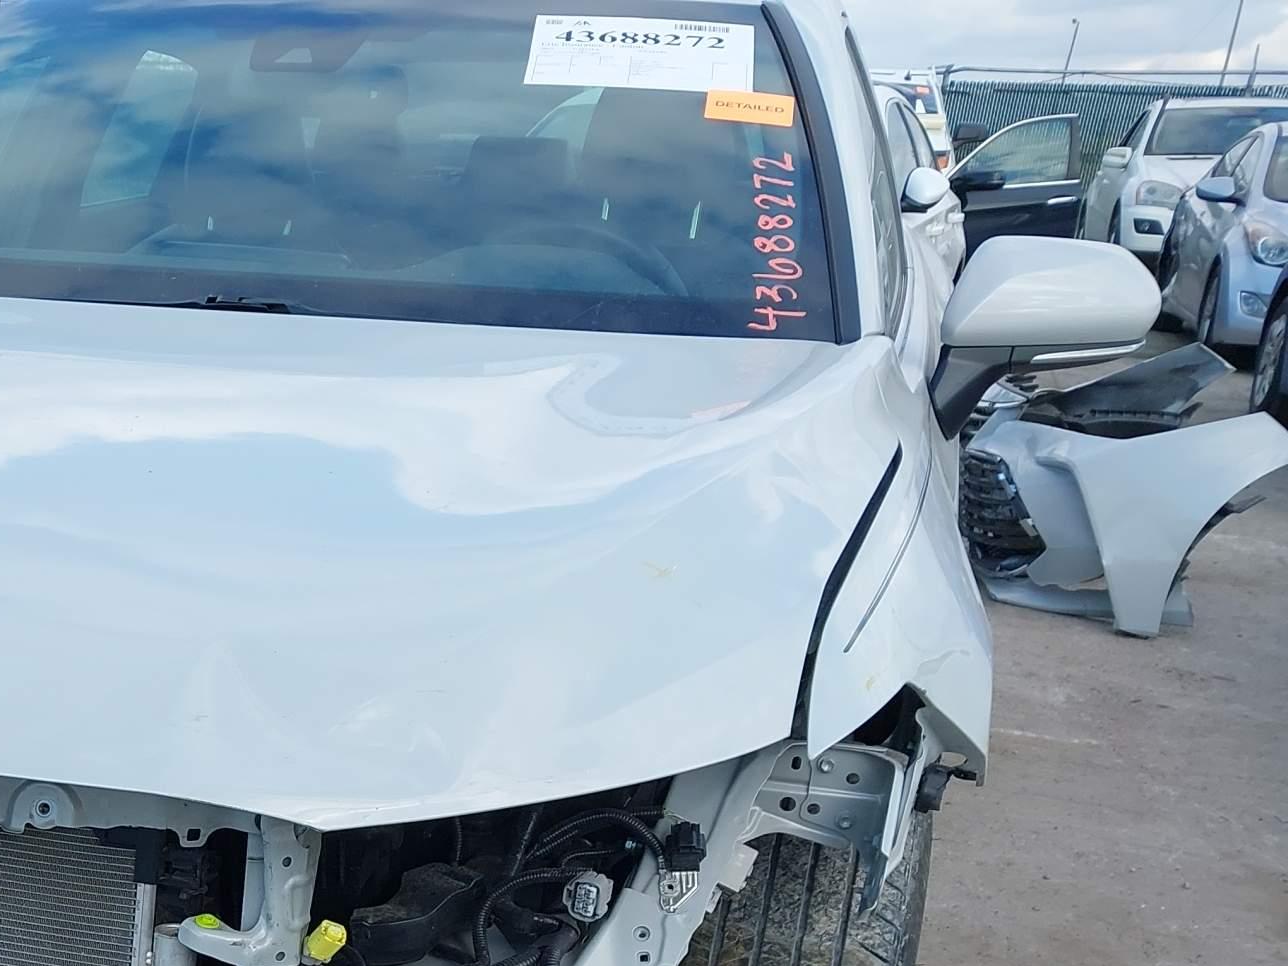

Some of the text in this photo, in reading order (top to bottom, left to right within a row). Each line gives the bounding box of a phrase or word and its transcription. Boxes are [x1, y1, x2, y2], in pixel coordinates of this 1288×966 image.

[555, 29, 726, 49] 43688272
[714, 100, 785, 114] DETAILED
[746, 151, 808, 331] 43688272
